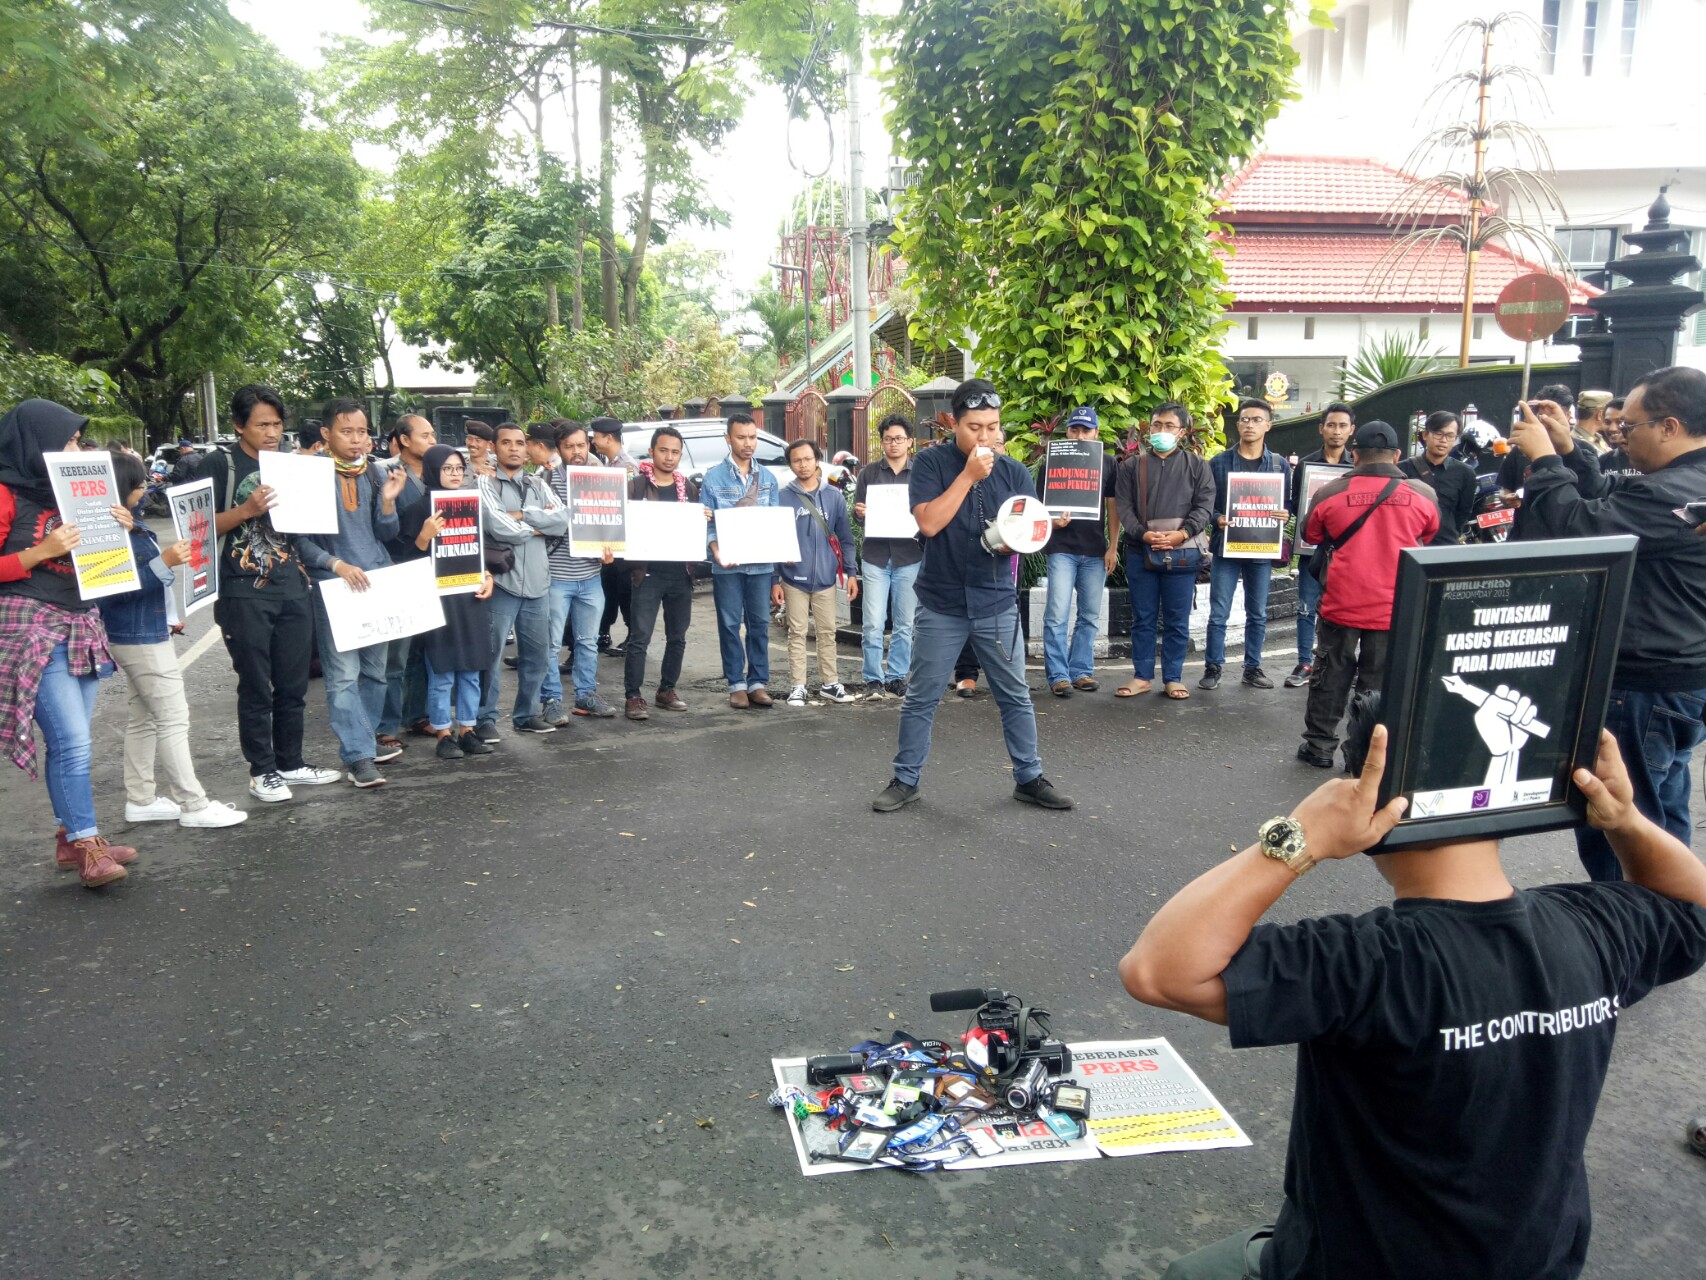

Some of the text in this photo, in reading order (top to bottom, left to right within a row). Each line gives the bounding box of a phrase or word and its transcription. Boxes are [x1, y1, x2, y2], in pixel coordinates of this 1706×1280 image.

[59, 465, 107, 477] KEBEBASAN
[69, 480, 108, 497] PERS
[178, 492, 210, 515] STOP
[572, 513, 622, 525] JURNALIS
[1230, 516, 1278, 528] JURNALIS
[435, 542, 479, 558] JURNALIS
[1473, 604, 1551, 626] TUNTASKAN
[1445, 625, 1569, 651] KASUS KEKERASAN
[1452, 649, 1556, 673] PADA JURNALIS!
[1439, 1023, 1484, 1051] THE
[1073, 1048, 1159, 1061] EBEBASAN
[1079, 1059, 1159, 1076] PERS
[1091, 1097, 1197, 1113] TENTANG PERS
